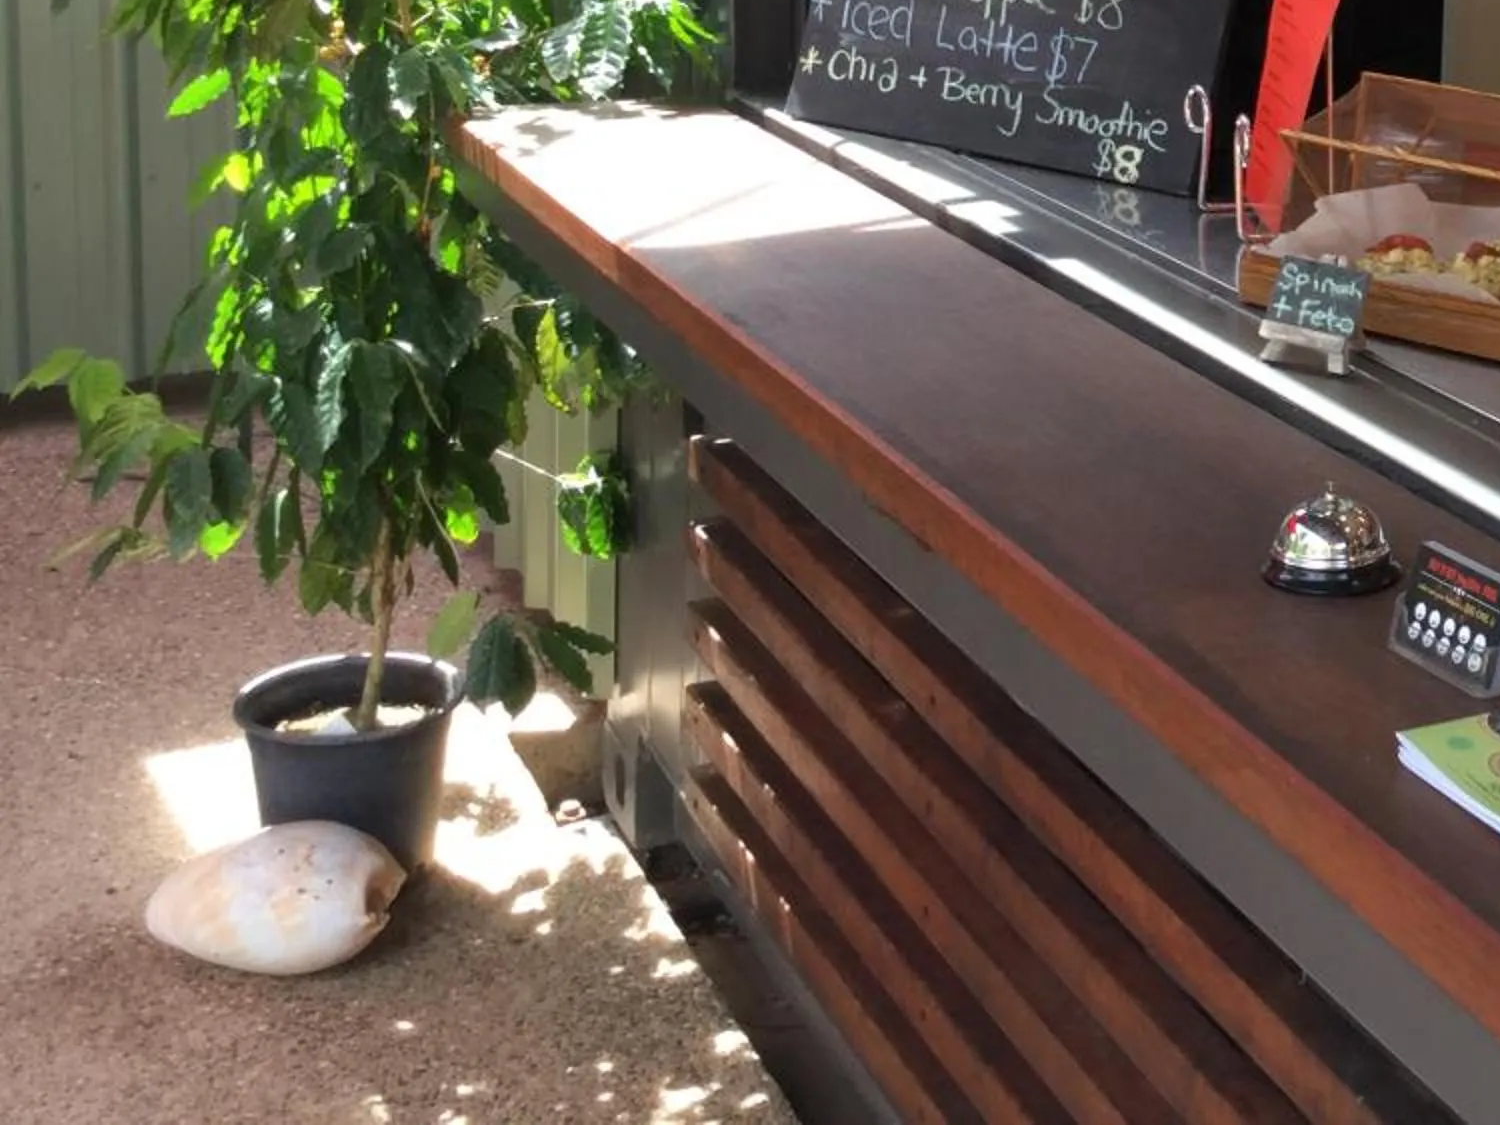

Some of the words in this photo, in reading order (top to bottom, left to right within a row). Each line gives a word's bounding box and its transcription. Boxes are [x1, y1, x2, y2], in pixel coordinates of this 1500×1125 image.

[936, 4, 1039, 72] Latte
[1045, 27, 1098, 85] $7
[935, 66, 1023, 137] Berry
[1036, 83, 1169, 152] Smoothie
[1091, 138, 1145, 184] $8
